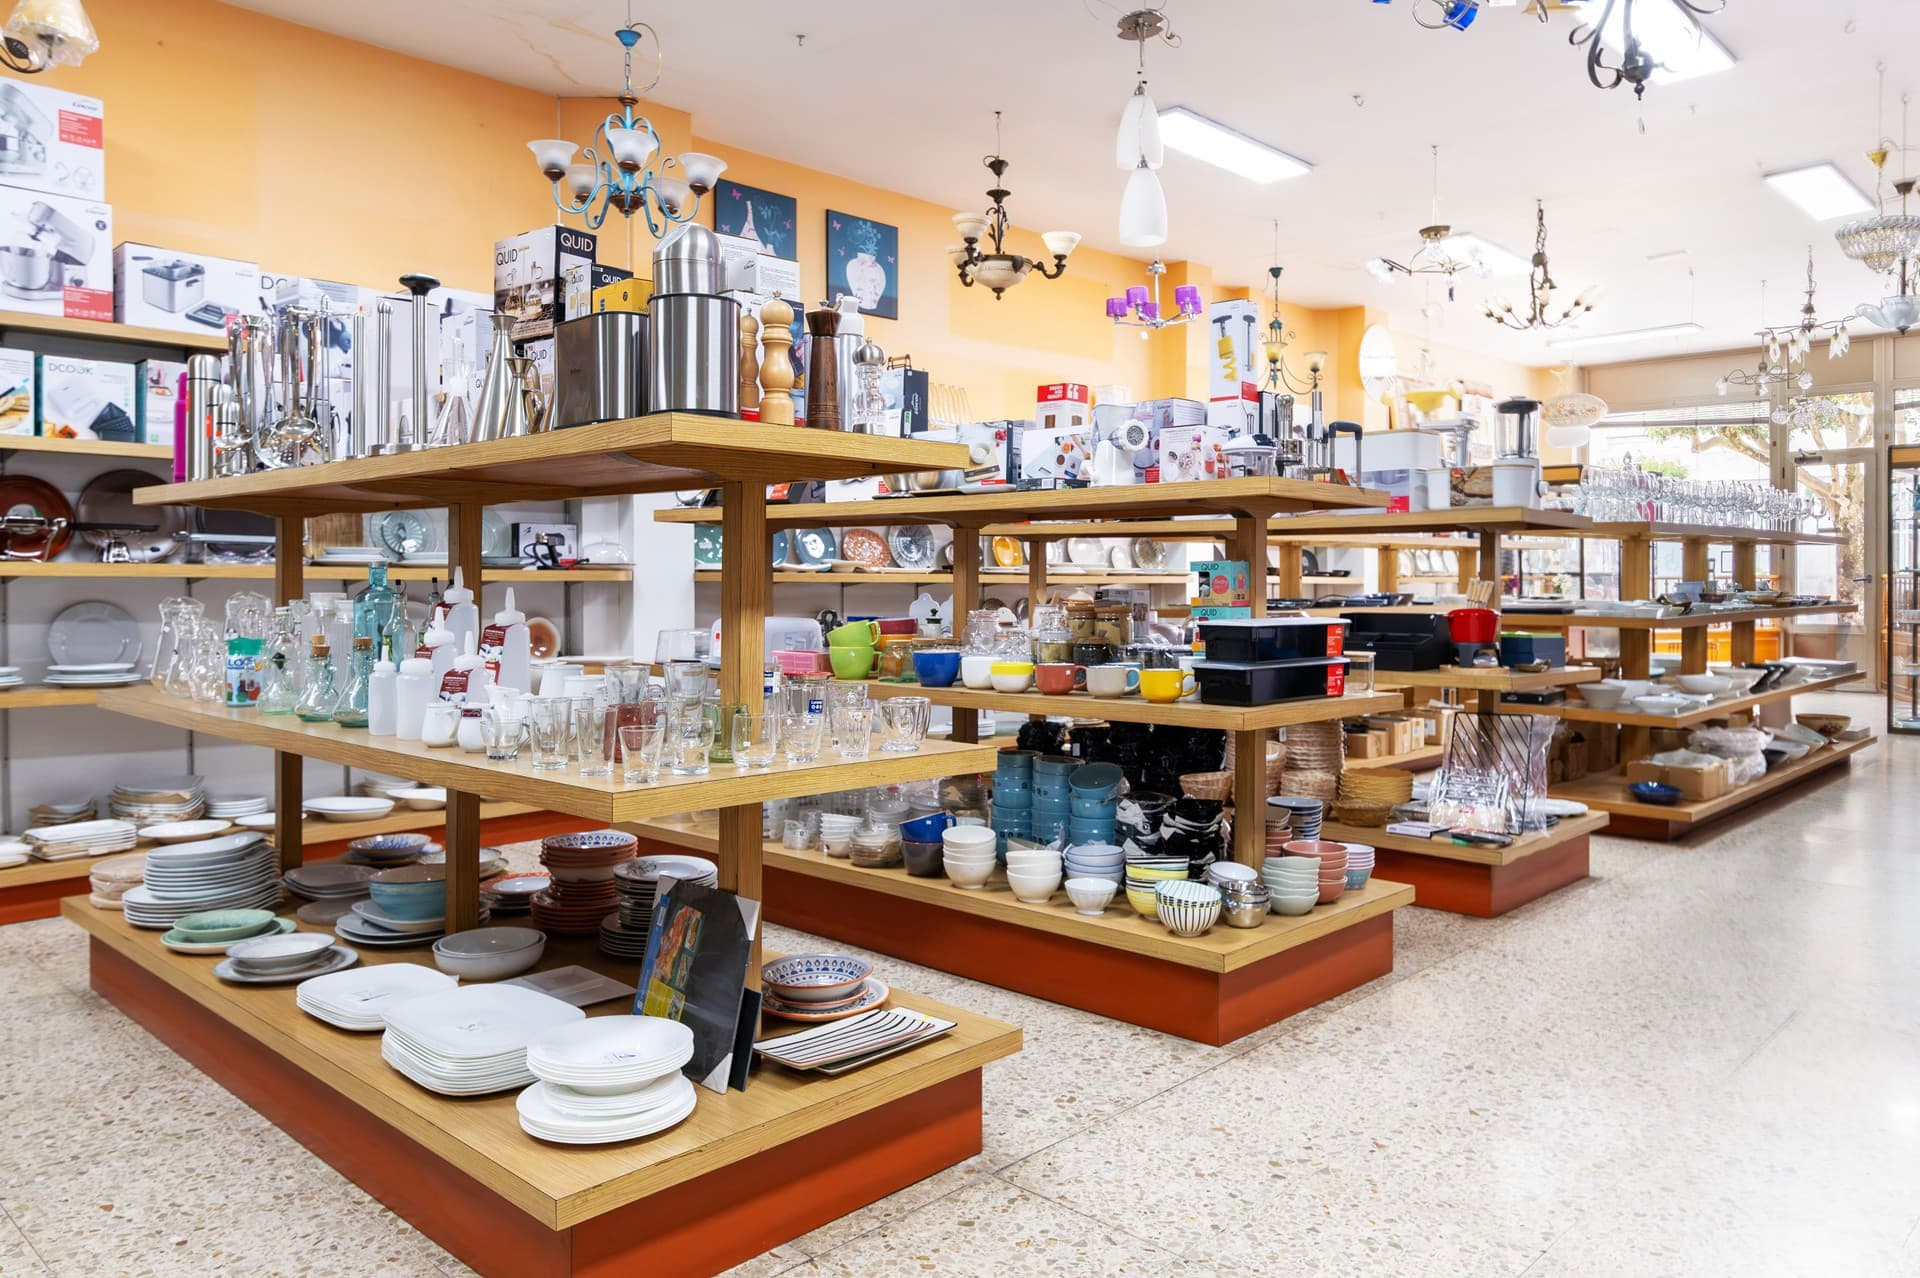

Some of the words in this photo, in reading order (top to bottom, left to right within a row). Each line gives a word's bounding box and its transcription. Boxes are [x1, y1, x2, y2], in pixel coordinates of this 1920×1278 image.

[560, 233, 593, 252] QUID
[496, 248, 517, 265] QUID
[531, 349, 548, 360] QUID
[1201, 563, 1219, 571] QUID
